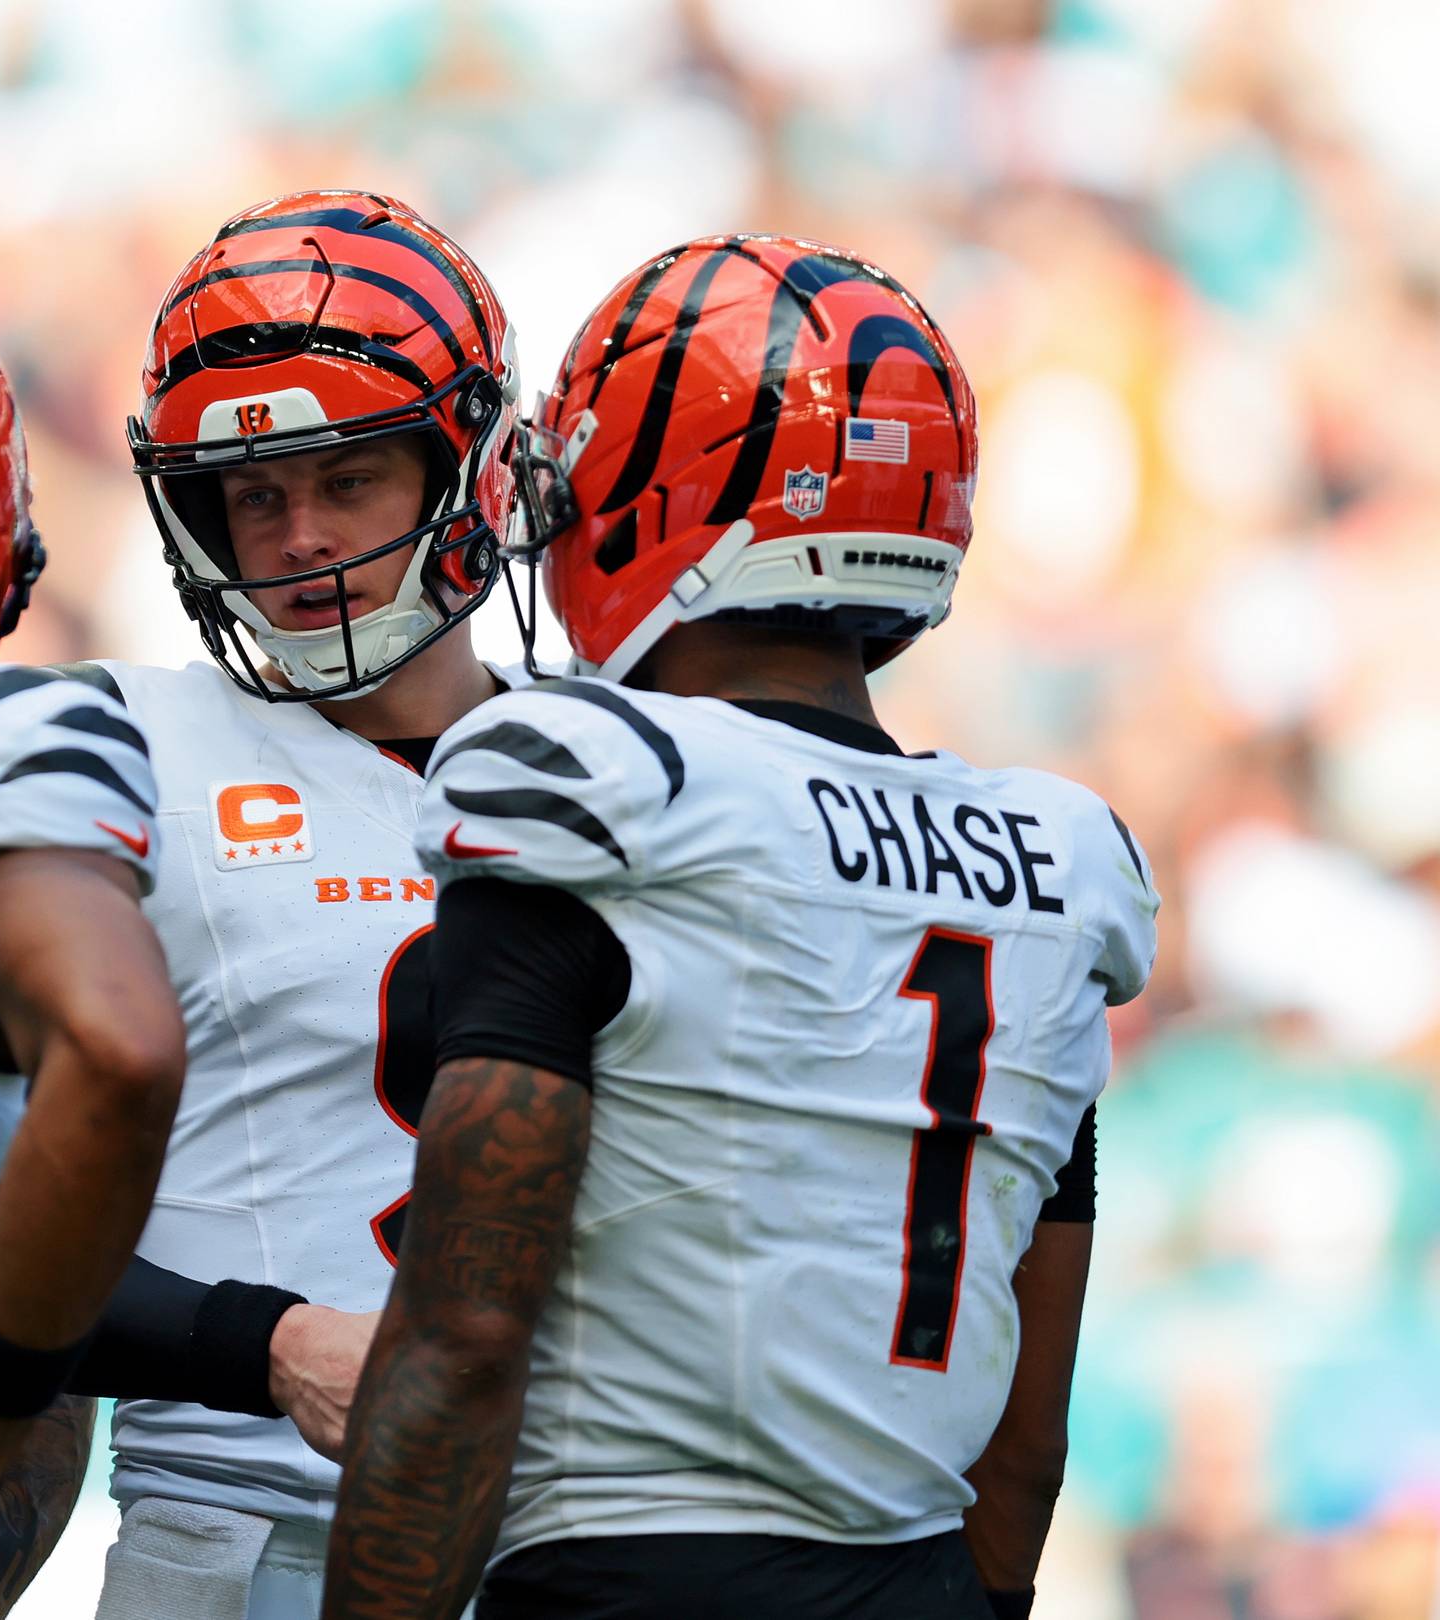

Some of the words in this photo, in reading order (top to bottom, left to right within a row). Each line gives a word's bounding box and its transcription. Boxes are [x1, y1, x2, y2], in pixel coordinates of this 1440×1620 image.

[789, 488, 818, 510] NFL
[917, 471, 934, 530] 1
[843, 550, 948, 572] BENGALS
[216, 783, 304, 843] C
[807, 777, 1064, 914] CHASE
[314, 877, 436, 902] BEN
[889, 925, 994, 1373] 1
